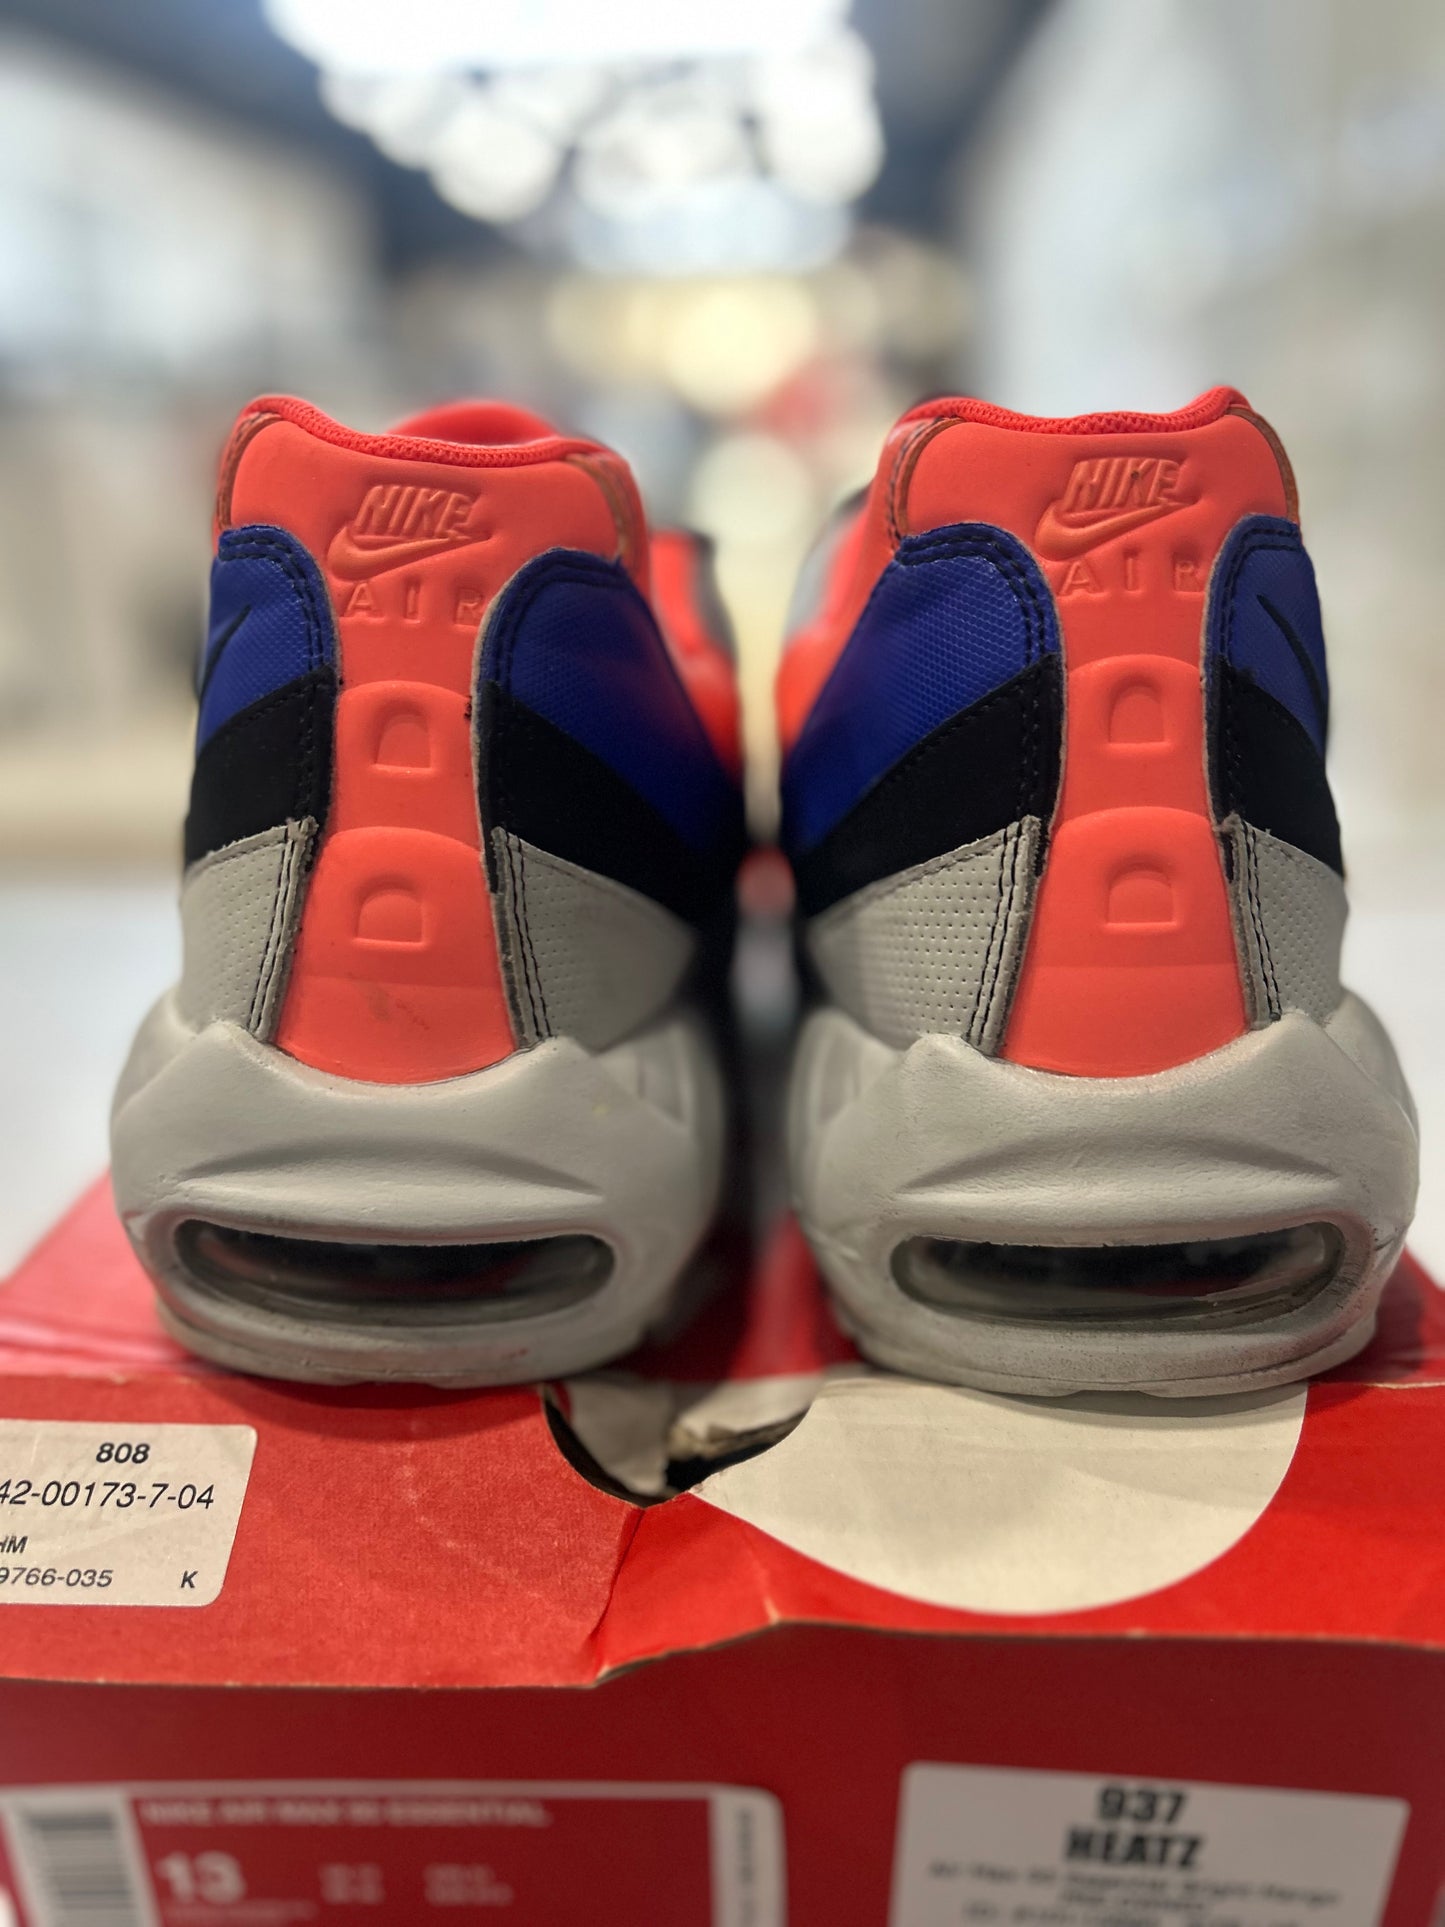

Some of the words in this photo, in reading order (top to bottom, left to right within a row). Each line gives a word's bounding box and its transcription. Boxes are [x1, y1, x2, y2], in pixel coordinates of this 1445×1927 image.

[1061, 457, 1183, 511] NIKE
[353, 484, 475, 538] NIKE
[1058, 555, 1206, 597] AIR
[342, 580, 486, 628] AIR
[96, 1442, 150, 1464] 808
[180, 1570, 198, 1589] K
[1096, 1784, 1188, 1824] 937
[1064, 1825, 1206, 1869] HEATZ
[155, 1851, 247, 1904] 13
